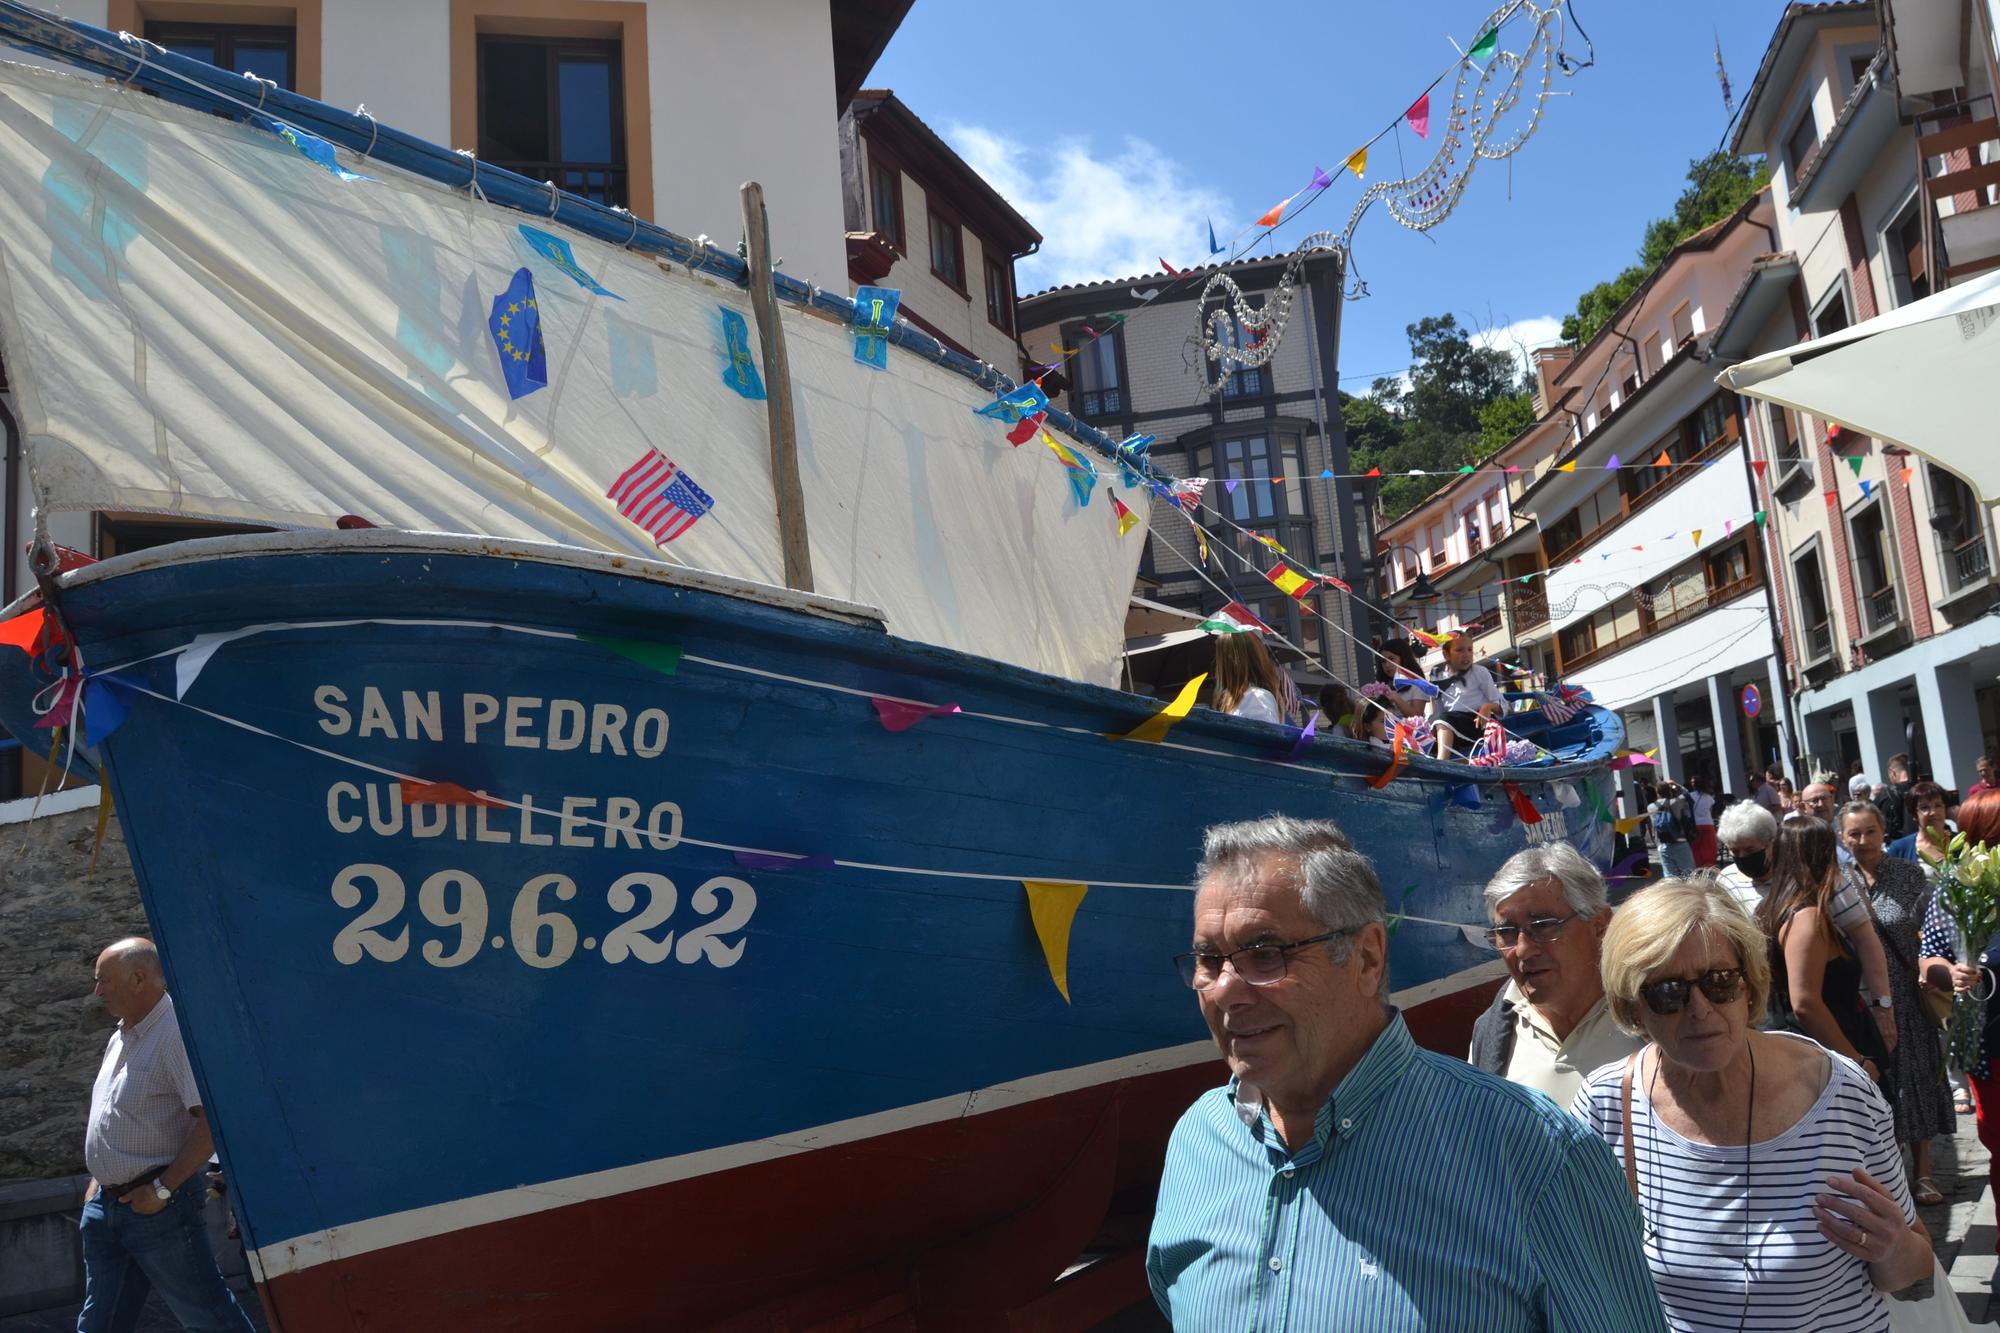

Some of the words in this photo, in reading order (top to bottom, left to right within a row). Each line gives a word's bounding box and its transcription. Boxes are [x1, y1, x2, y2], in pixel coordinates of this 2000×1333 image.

[315, 686, 443, 741] SAN
[464, 694, 669, 758] PEDRO
[328, 782, 683, 850] CUDILLERO
[332, 864, 756, 968] 29.6.22
